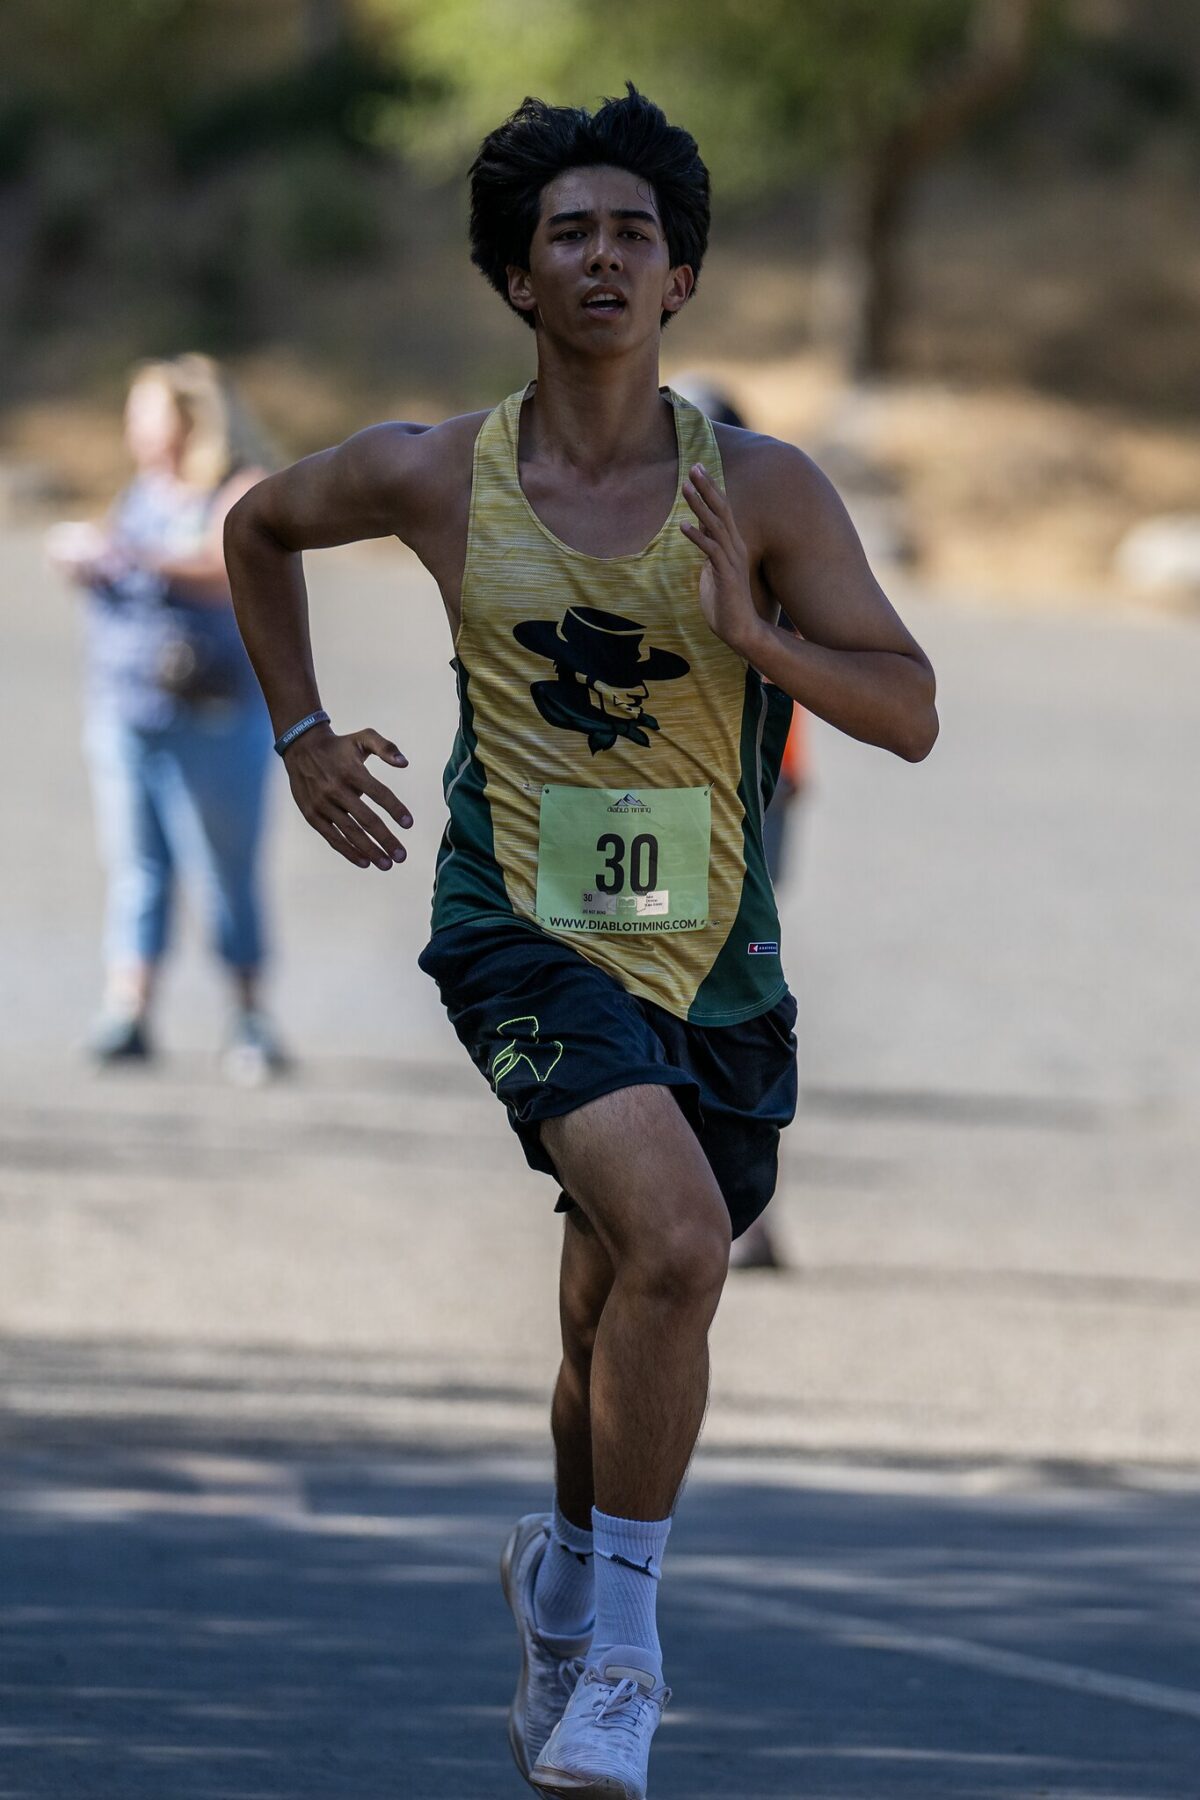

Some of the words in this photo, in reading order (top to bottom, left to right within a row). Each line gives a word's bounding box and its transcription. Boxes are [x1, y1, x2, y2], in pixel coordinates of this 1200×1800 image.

[595, 833, 659, 896] 30
[583, 893, 592, 902] 30
[550, 917, 697, 932] WWW.DIABLOTIMING.COM
